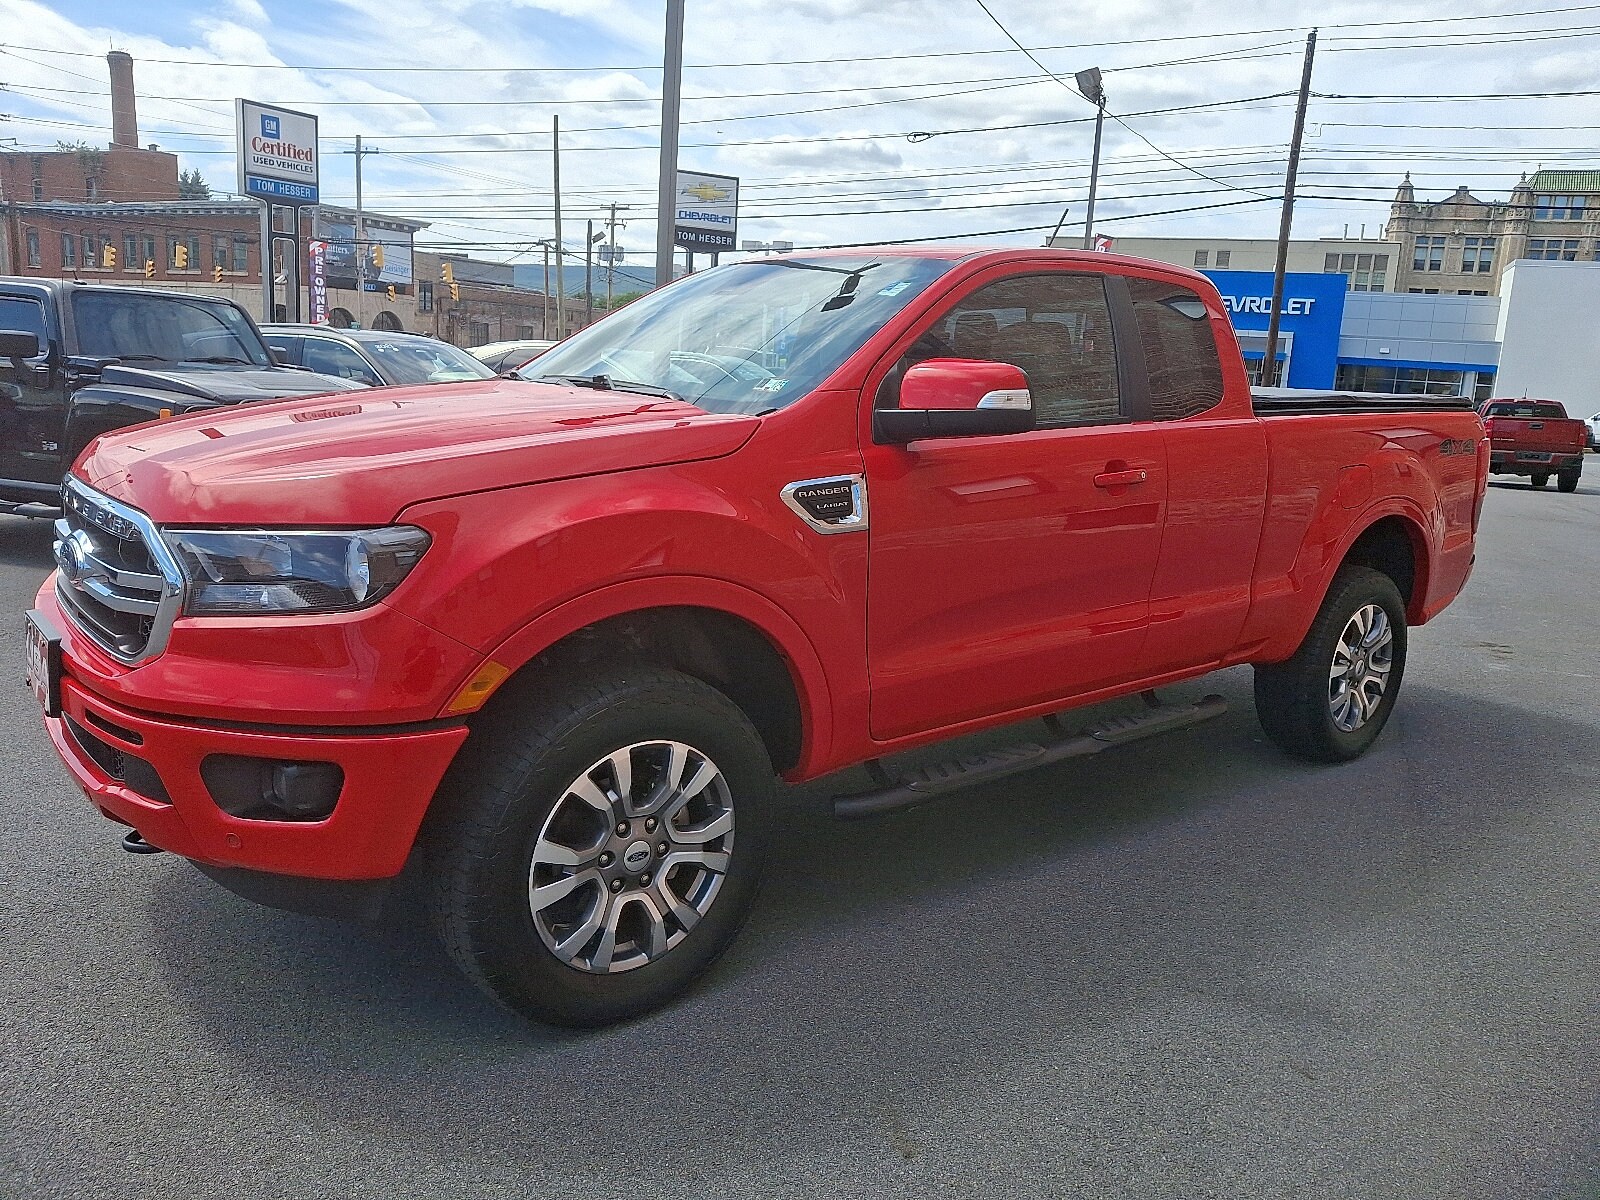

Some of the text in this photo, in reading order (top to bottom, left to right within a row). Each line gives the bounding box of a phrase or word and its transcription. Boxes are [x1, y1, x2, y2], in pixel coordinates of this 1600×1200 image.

[265, 119, 277, 131] GM
[252, 136, 313, 162] Certified
[253, 155, 313, 173] USED VEHICLES
[257, 180, 311, 198] TOM HESSER
[679, 210, 732, 224] CHEVROLET
[678, 231, 732, 246] TOM HESSER
[314, 246, 326, 322] PRE OWNED
[798, 486, 850, 498] RANGER
[816, 501, 849, 510] LARIAT
